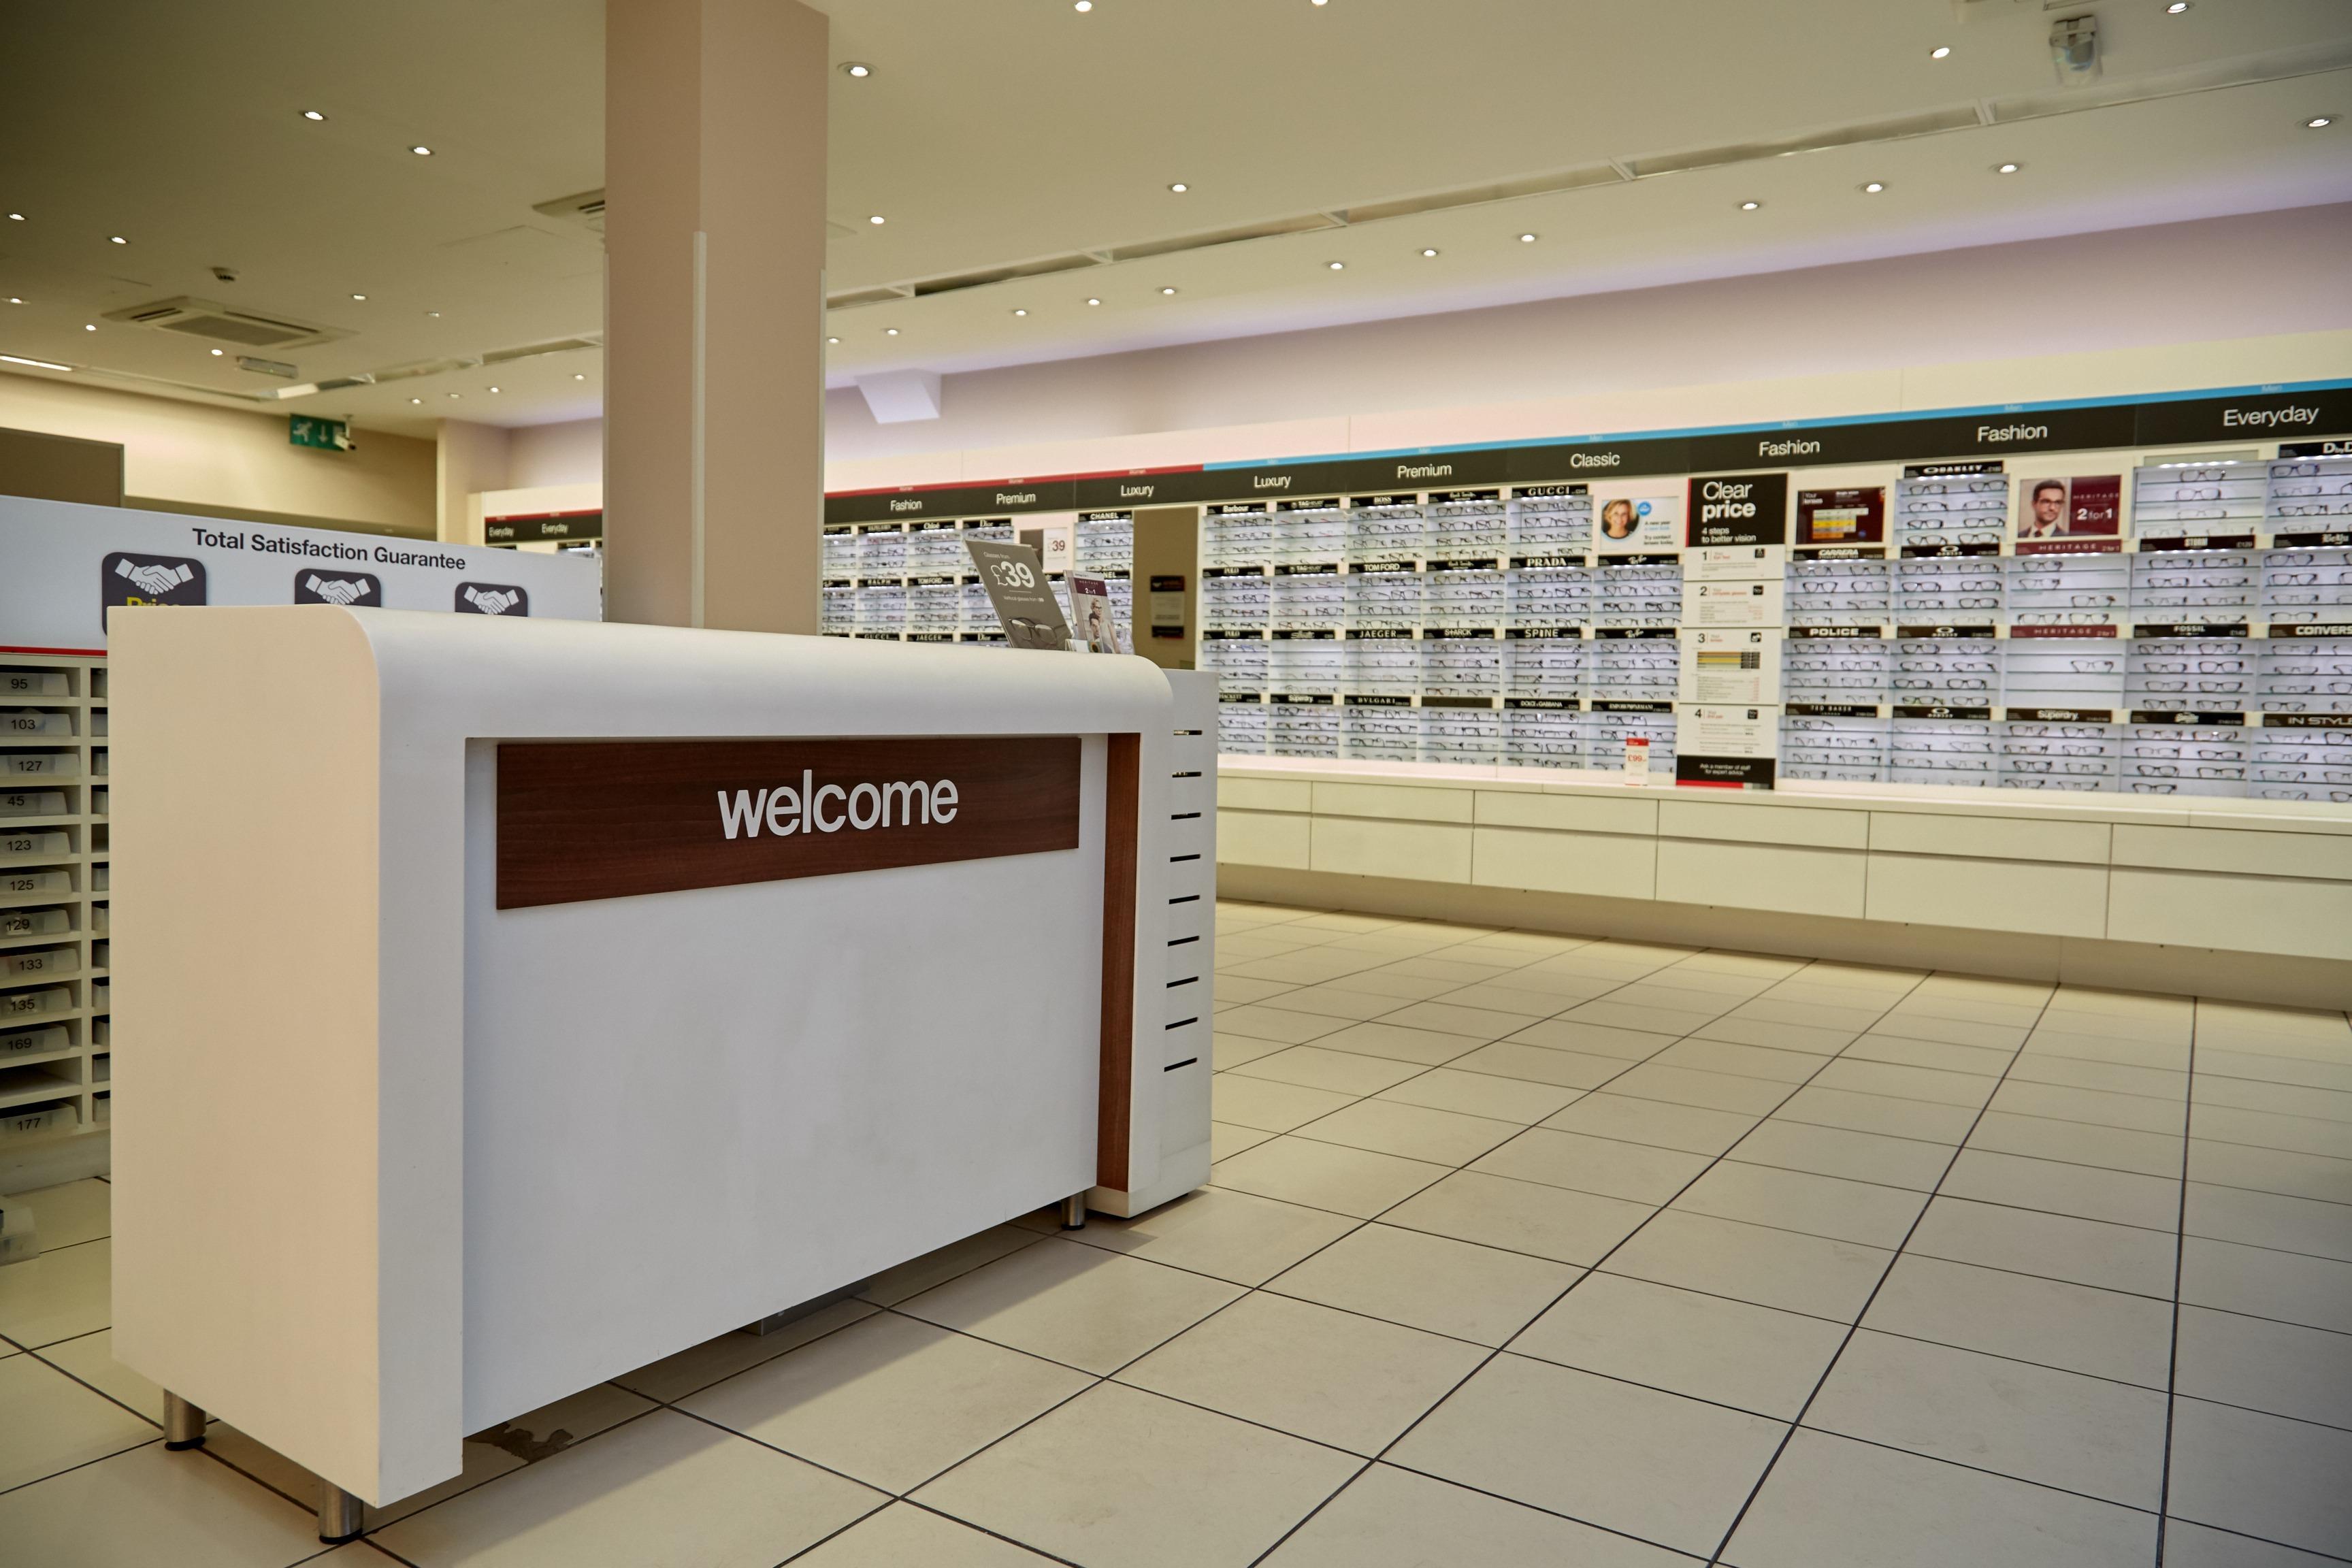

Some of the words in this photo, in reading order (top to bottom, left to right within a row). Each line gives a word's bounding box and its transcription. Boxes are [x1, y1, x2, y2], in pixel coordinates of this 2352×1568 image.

[2223, 405, 2319, 427] Everyday
[1978, 424, 2048, 442] Fashion
[1759, 439, 1820, 457] Fashion
[1570, 452, 1620, 468] Classic
[1397, 463, 1452, 478] Premium
[1254, 475, 1292, 489] Luxury
[1121, 485, 1154, 497] Luxury
[1528, 486, 1570, 496] GUCCI
[1702, 480, 1753, 500] Clear
[996, 492, 1036, 504] Premium
[890, 500, 922, 511] Fashion
[1702, 500, 1756, 523] price
[2077, 508, 2088, 520] 2
[2089, 510, 2104, 519] for
[2106, 508, 2112, 519] 1
[489, 527, 514, 537] Everyday
[541, 523, 568, 534] Everyday
[1709, 527, 1730, 535] steps
[1735, 534, 1757, 542] vision
[192, 527, 244, 549] Total
[251, 534, 368, 561] Satisfaction
[374, 546, 466, 570] Guarantee
[2038, 543, 2097, 551] HERITAGE
[1702, 551, 1708, 561] 1
[1526, 557, 1567, 567] PRADA
[991, 561, 1034, 588] £39
[1700, 586, 1708, 596] 2
[1360, 630, 1396, 638] JAEGER
[1524, 629, 1558, 638] SPINE
[1810, 628, 1859, 636] POLICE
[1698, 633, 1705, 643] 3
[11, 679, 28, 689] 95
[1695, 708, 1702, 719] 4
[11, 719, 35, 730] 103
[18, 761, 42, 771] 127
[7, 796, 24, 806] 45
[717, 769, 958, 839] welcome
[7, 840, 31, 851] 123
[10, 879, 34, 891] 125
[5, 919, 30, 931] 129
[19, 959, 43, 970] 133
[11, 998, 35, 1011] 135
[7, 1038, 32, 1050] 169
[17, 1117, 41, 1131] 177
